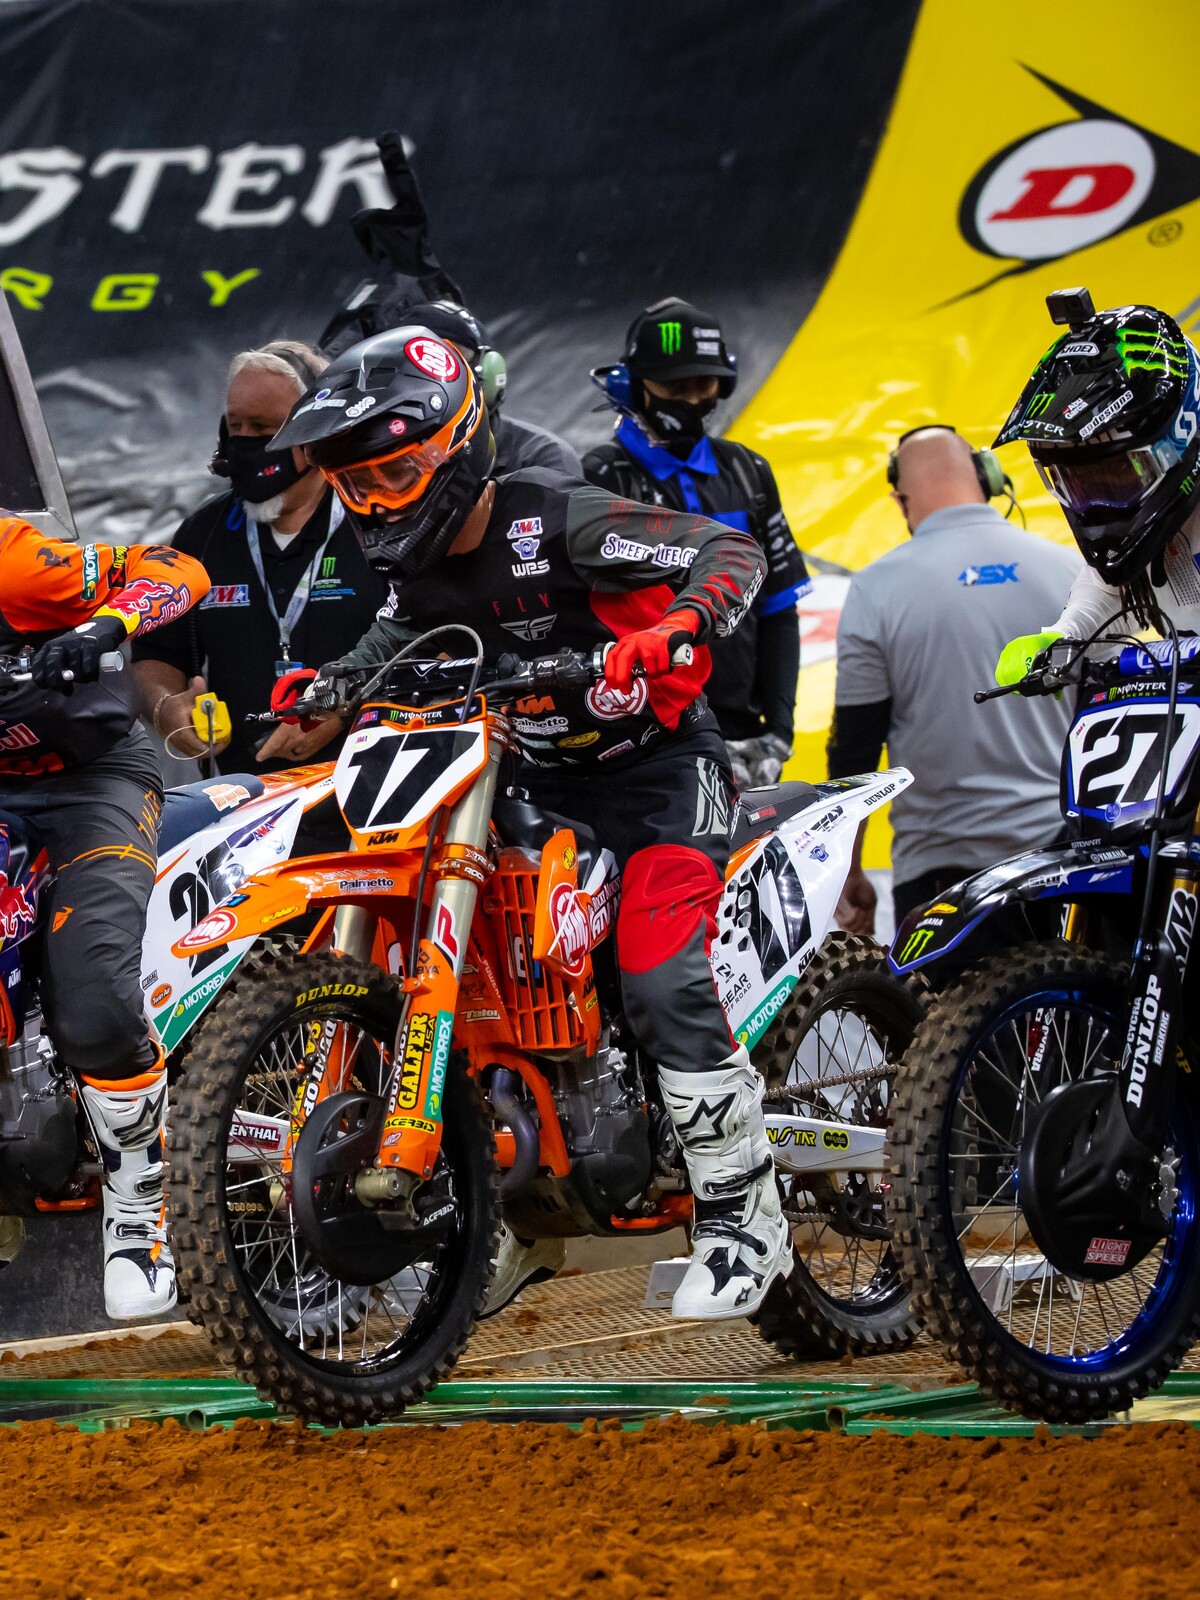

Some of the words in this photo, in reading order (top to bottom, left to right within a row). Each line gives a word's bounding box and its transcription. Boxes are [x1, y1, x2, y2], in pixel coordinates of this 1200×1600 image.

[510, 520, 541, 536] AMA
[602, 534, 649, 560] SWEET
[652, 544, 680, 567] LIFE
[680, 549, 699, 567] CB
[512, 559, 550, 577] WPS
[1116, 681, 1167, 694] MONSTER
[1079, 707, 1186, 809] 27
[342, 729, 480, 829] 17
[863, 783, 896, 807] DUNLOP
[367, 830, 400, 847] KTM
[1098, 849, 1128, 862] YAMAHA
[339, 876, 394, 890] Palmetto
[798, 946, 817, 973] KTM
[8, 968, 21, 989] KTM
[184, 971, 227, 1012] MOTOREX
[295, 983, 369, 1007] DUNLOP
[746, 984, 793, 1037] MOTOREX
[1127, 996, 1142, 1043] CYCRA
[423, 1017, 437, 1054] USA
[1126, 974, 1162, 1109] DUNLOP
[1153, 1011, 1171, 1066] BRAKING
[398, 1012, 430, 1110] GALFER
[430, 1018, 452, 1093] MOTOREX
[229, 1123, 280, 1142] ENTHAL
[384, 1117, 436, 1134] ACERBIS
[765, 1126, 817, 1147] NSTAR
[422, 1203, 455, 1227] ACERBIS
[1087, 1252, 1127, 1263] SPEED
[1091, 1239, 1131, 1252] LIGHT
